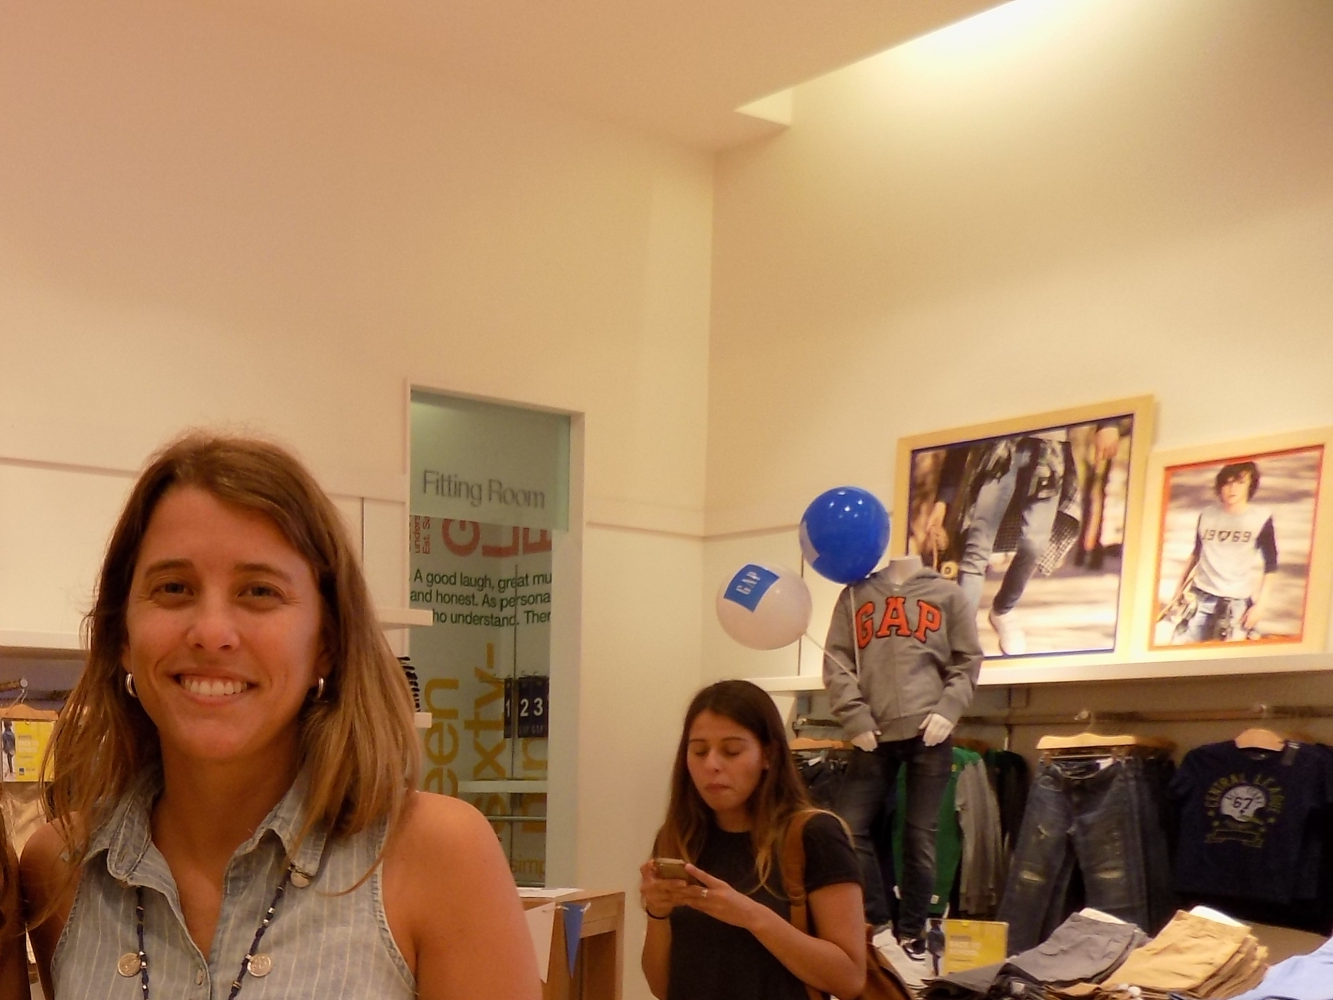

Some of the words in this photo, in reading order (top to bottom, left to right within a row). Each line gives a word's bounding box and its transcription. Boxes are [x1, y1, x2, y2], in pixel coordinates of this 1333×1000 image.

[423, 470, 482, 507] Fitting
[488, 479, 545, 509] Room
[414, 568, 423, 582] A
[426, 572, 456, 587] good
[460, 572, 495, 592] laugh,
[498, 574, 529, 593] great
[736, 571, 761, 595] GAP
[410, 590, 432, 602] and
[436, 590, 478, 606] honest.
[481, 594, 497, 608] As
[432, 608, 447, 623] ho
[451, 612, 519, 627] understand.
[855, 596, 942, 649] GAP
[520, 698, 529, 717] 2
[533, 697, 544, 716] 3
[1233, 796, 1254, 809] 67
